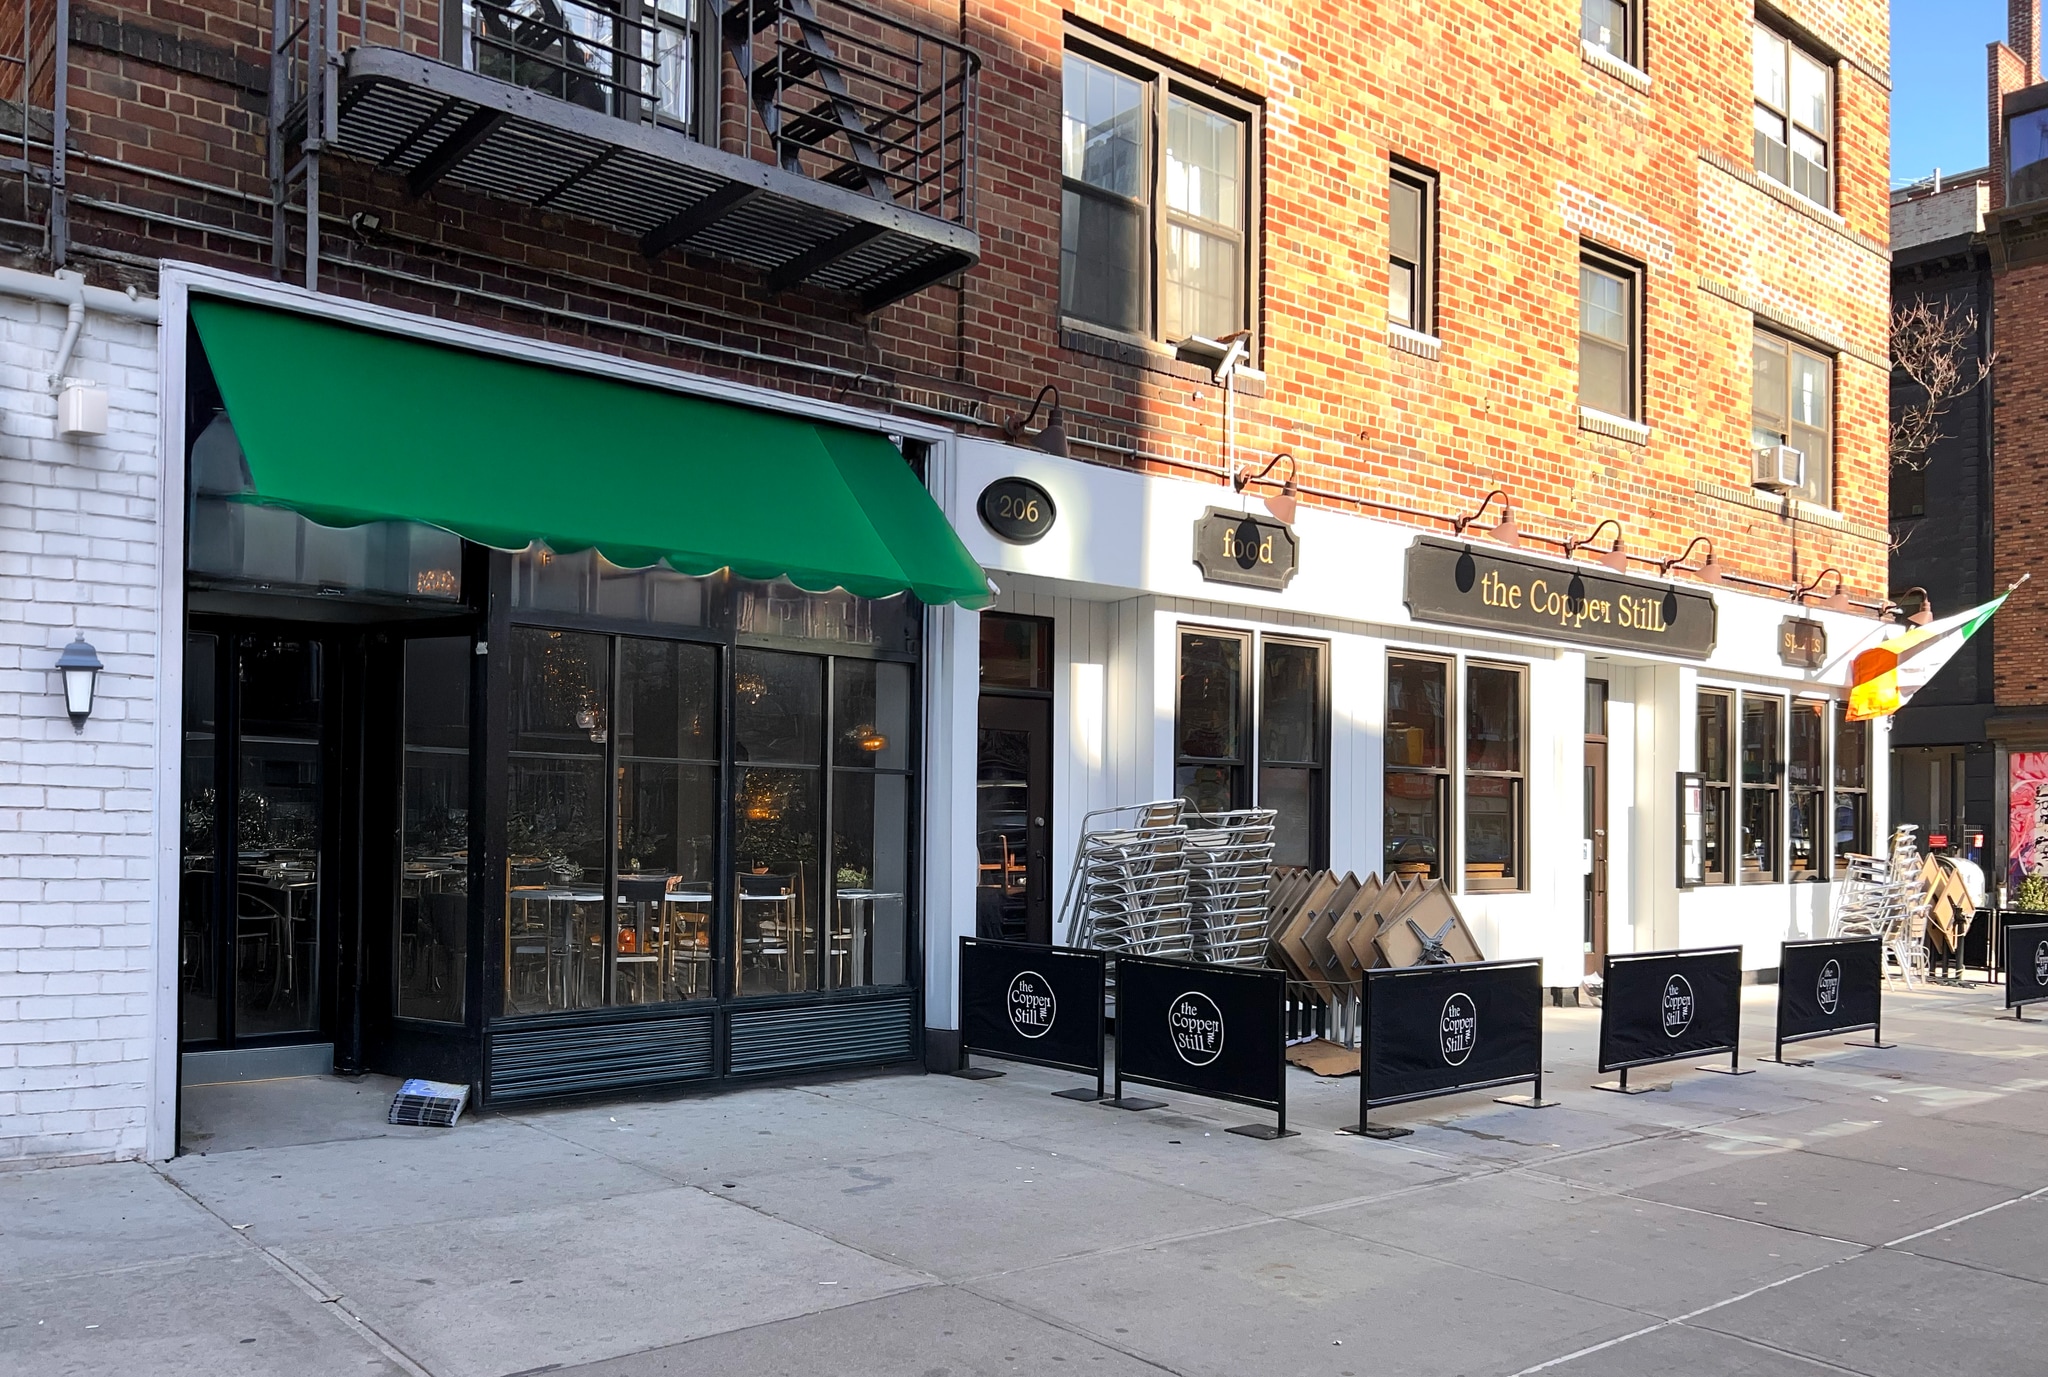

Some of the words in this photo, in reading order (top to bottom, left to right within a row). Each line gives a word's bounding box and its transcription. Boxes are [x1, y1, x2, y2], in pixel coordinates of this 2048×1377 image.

[999, 495, 1040, 524] 206
[1222, 528, 1274, 565] food
[1481, 570, 1522, 610] the
[1530, 579, 1612, 628] Copper
[1019, 980, 1034, 993] the
[1668, 984, 1679, 996] the
[1011, 989, 1051, 1009] Copper
[1181, 1001, 1198, 1016] the
[1014, 1007, 1050, 1027] Still
[1448, 1004, 1461, 1018] the
[1172, 1012, 1219, 1034] Copper
[1442, 1017, 1474, 1035] Copper
[1178, 1032, 1217, 1054] Still
[1445, 1034, 1471, 1053] Still
